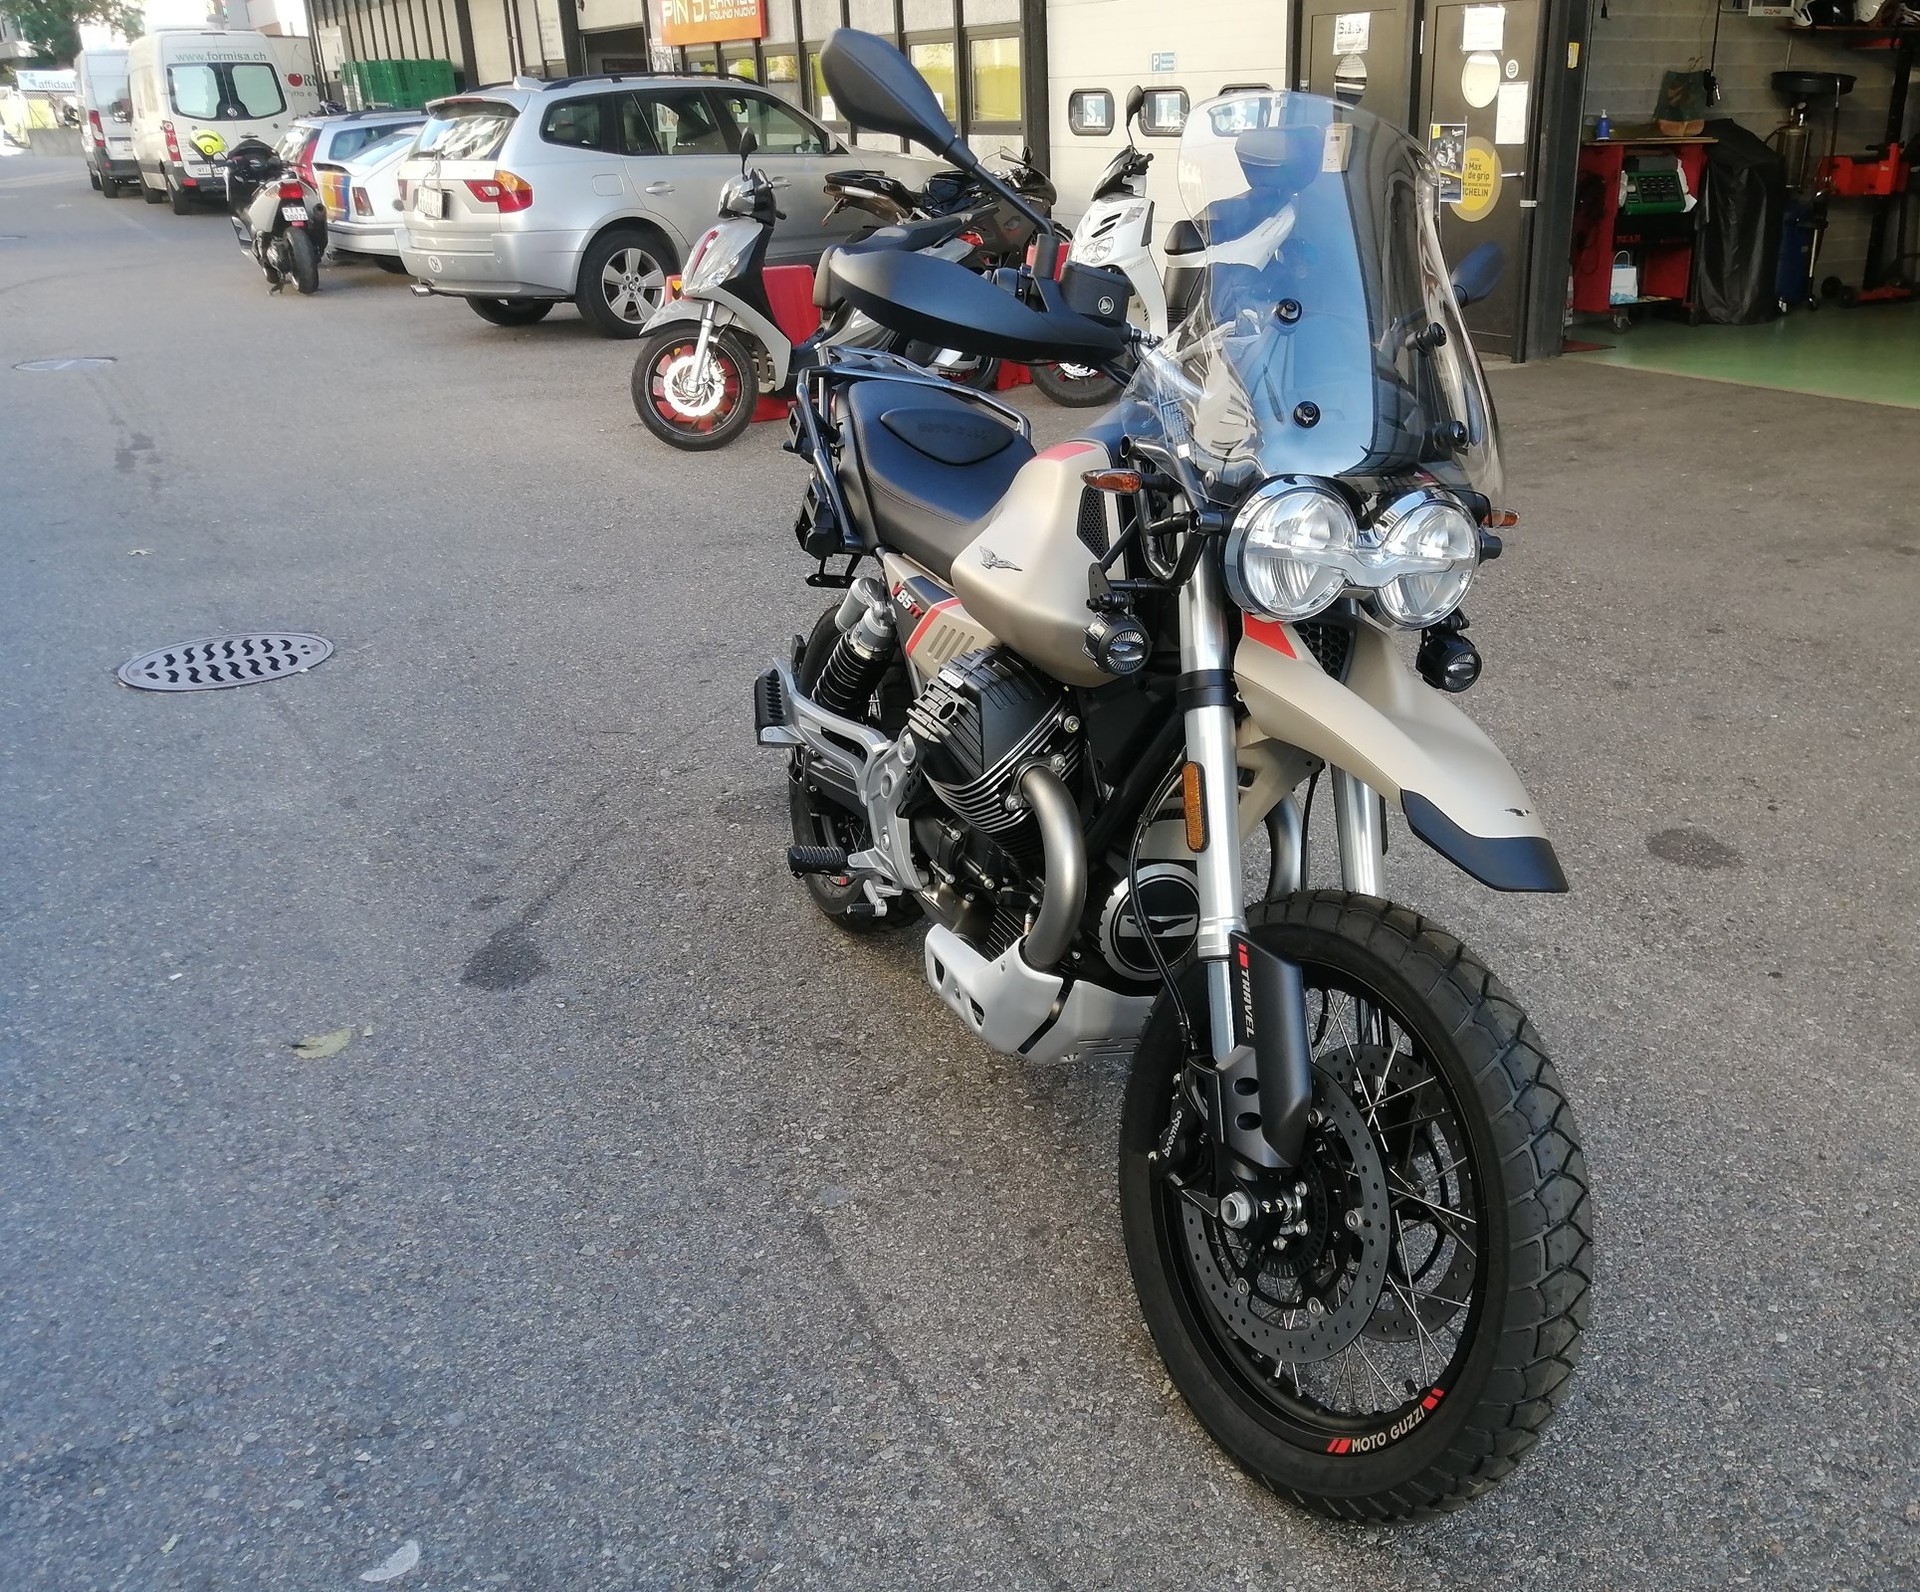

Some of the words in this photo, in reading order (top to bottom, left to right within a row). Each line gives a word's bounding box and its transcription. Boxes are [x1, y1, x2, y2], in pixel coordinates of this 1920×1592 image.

[175, 51, 267, 62] www.formisa.ch
[1468, 161, 1482, 171] Max
[1467, 171, 1476, 179] de
[1476, 172, 1490, 182] grip
[1463, 187, 1489, 197] ICHELIN
[1241, 969, 1255, 1038] TRAVEL
[1162, 1110, 1183, 1158] brembo
[1351, 1432, 1387, 1453] MOTO
[1390, 1405, 1425, 1440] GUZZI
